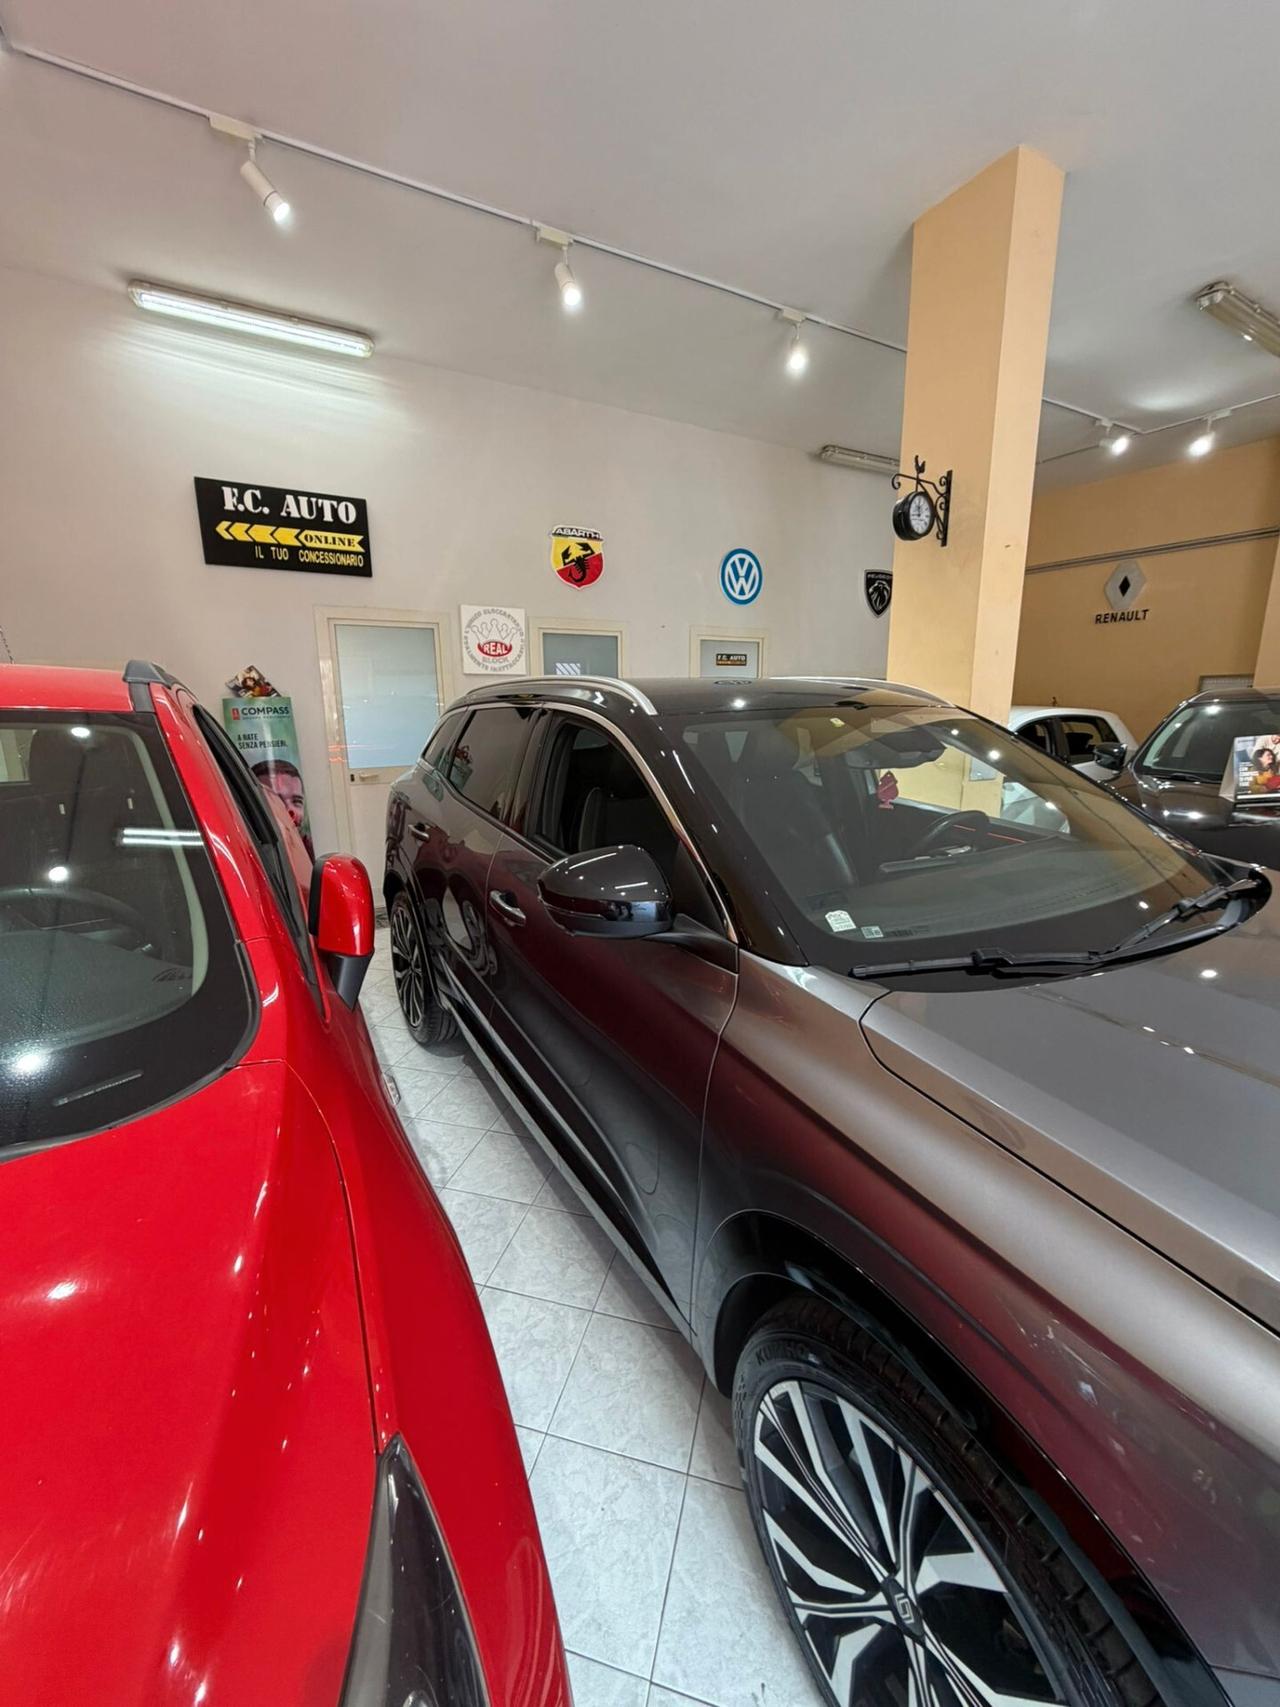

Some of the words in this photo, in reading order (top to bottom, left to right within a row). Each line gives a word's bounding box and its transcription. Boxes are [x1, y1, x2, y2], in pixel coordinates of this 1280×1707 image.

[221, 486, 270, 514] F.C.
[280, 494, 357, 524] AUTO
[555, 528, 599, 538] ABARTH
[304, 533, 356, 548] ONLINE
[255, 546, 264, 559] IL
[270, 546, 289, 561] TUO
[298, 550, 364, 567] CONCESSIONARIO
[1095, 609, 1149, 624] RENAULT
[483, 642, 508, 655] REAL
[241, 706, 290, 715] COMPASS
[238, 741, 258, 750] SENZA
